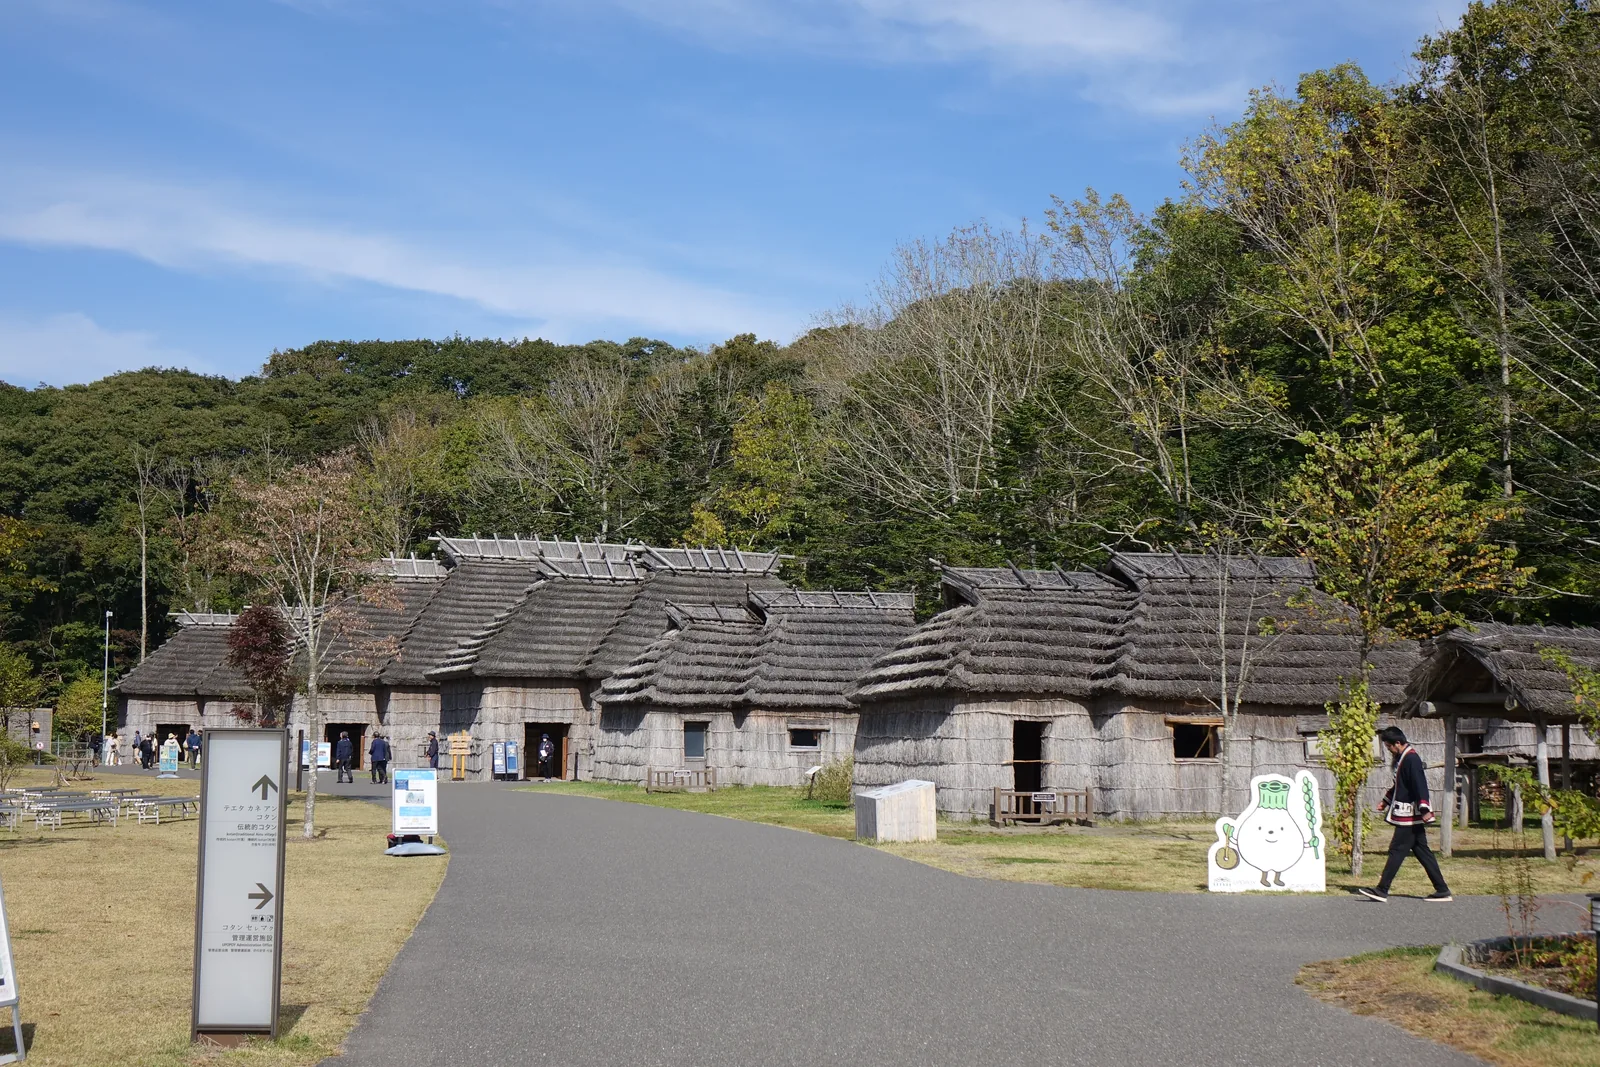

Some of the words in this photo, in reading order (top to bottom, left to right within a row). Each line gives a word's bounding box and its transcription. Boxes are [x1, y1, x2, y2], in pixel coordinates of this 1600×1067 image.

[237, 823, 277, 831] 伝統的コタン
[231, 934, 273, 942] 管理運営施設
